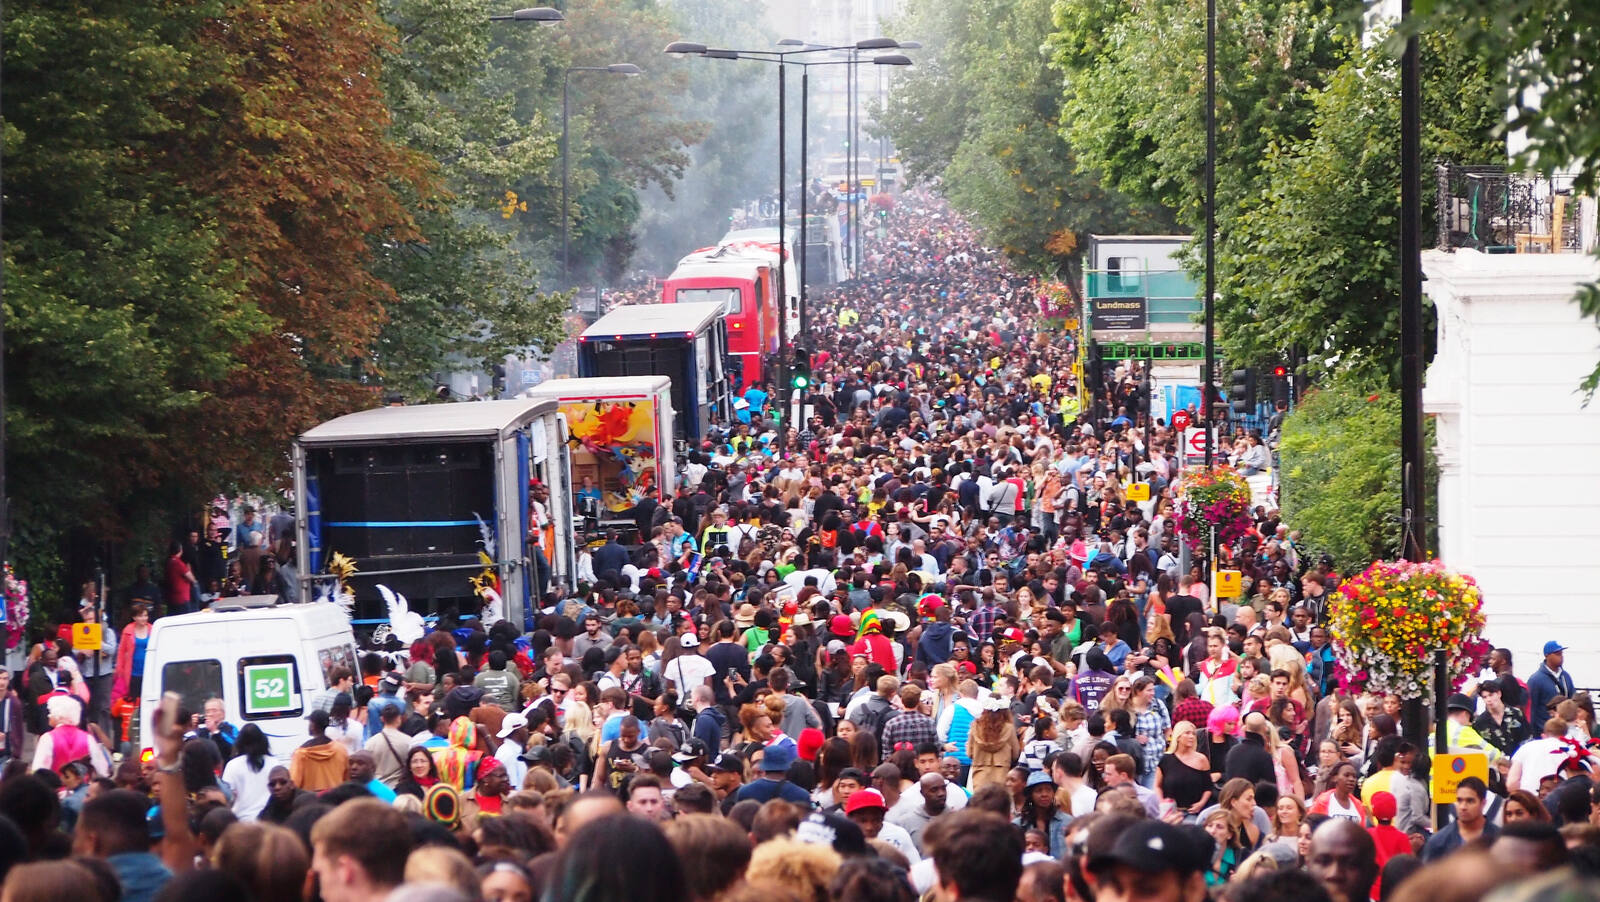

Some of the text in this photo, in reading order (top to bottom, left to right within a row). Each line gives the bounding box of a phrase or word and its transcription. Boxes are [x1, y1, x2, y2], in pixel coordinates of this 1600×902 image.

[1096, 301, 1141, 309] Landmass
[1174, 416, 1187, 424] PF
[255, 678, 285, 699] 52
